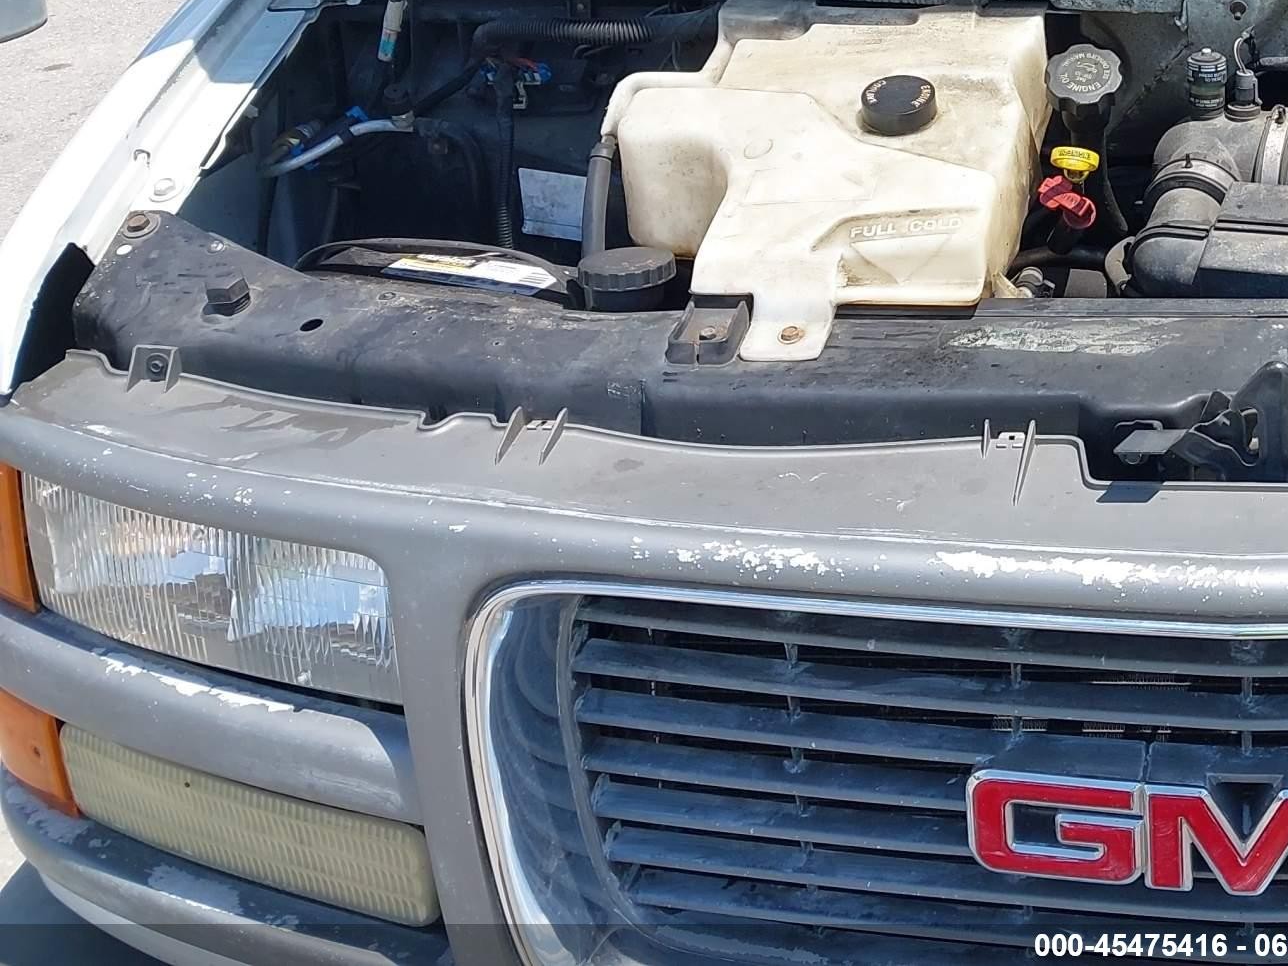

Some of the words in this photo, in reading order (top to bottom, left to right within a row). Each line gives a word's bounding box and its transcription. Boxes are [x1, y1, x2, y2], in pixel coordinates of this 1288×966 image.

[1066, 81, 1102, 93] ENGINE
[849, 222, 896, 238] FULL
[908, 216, 962, 233] COLD
